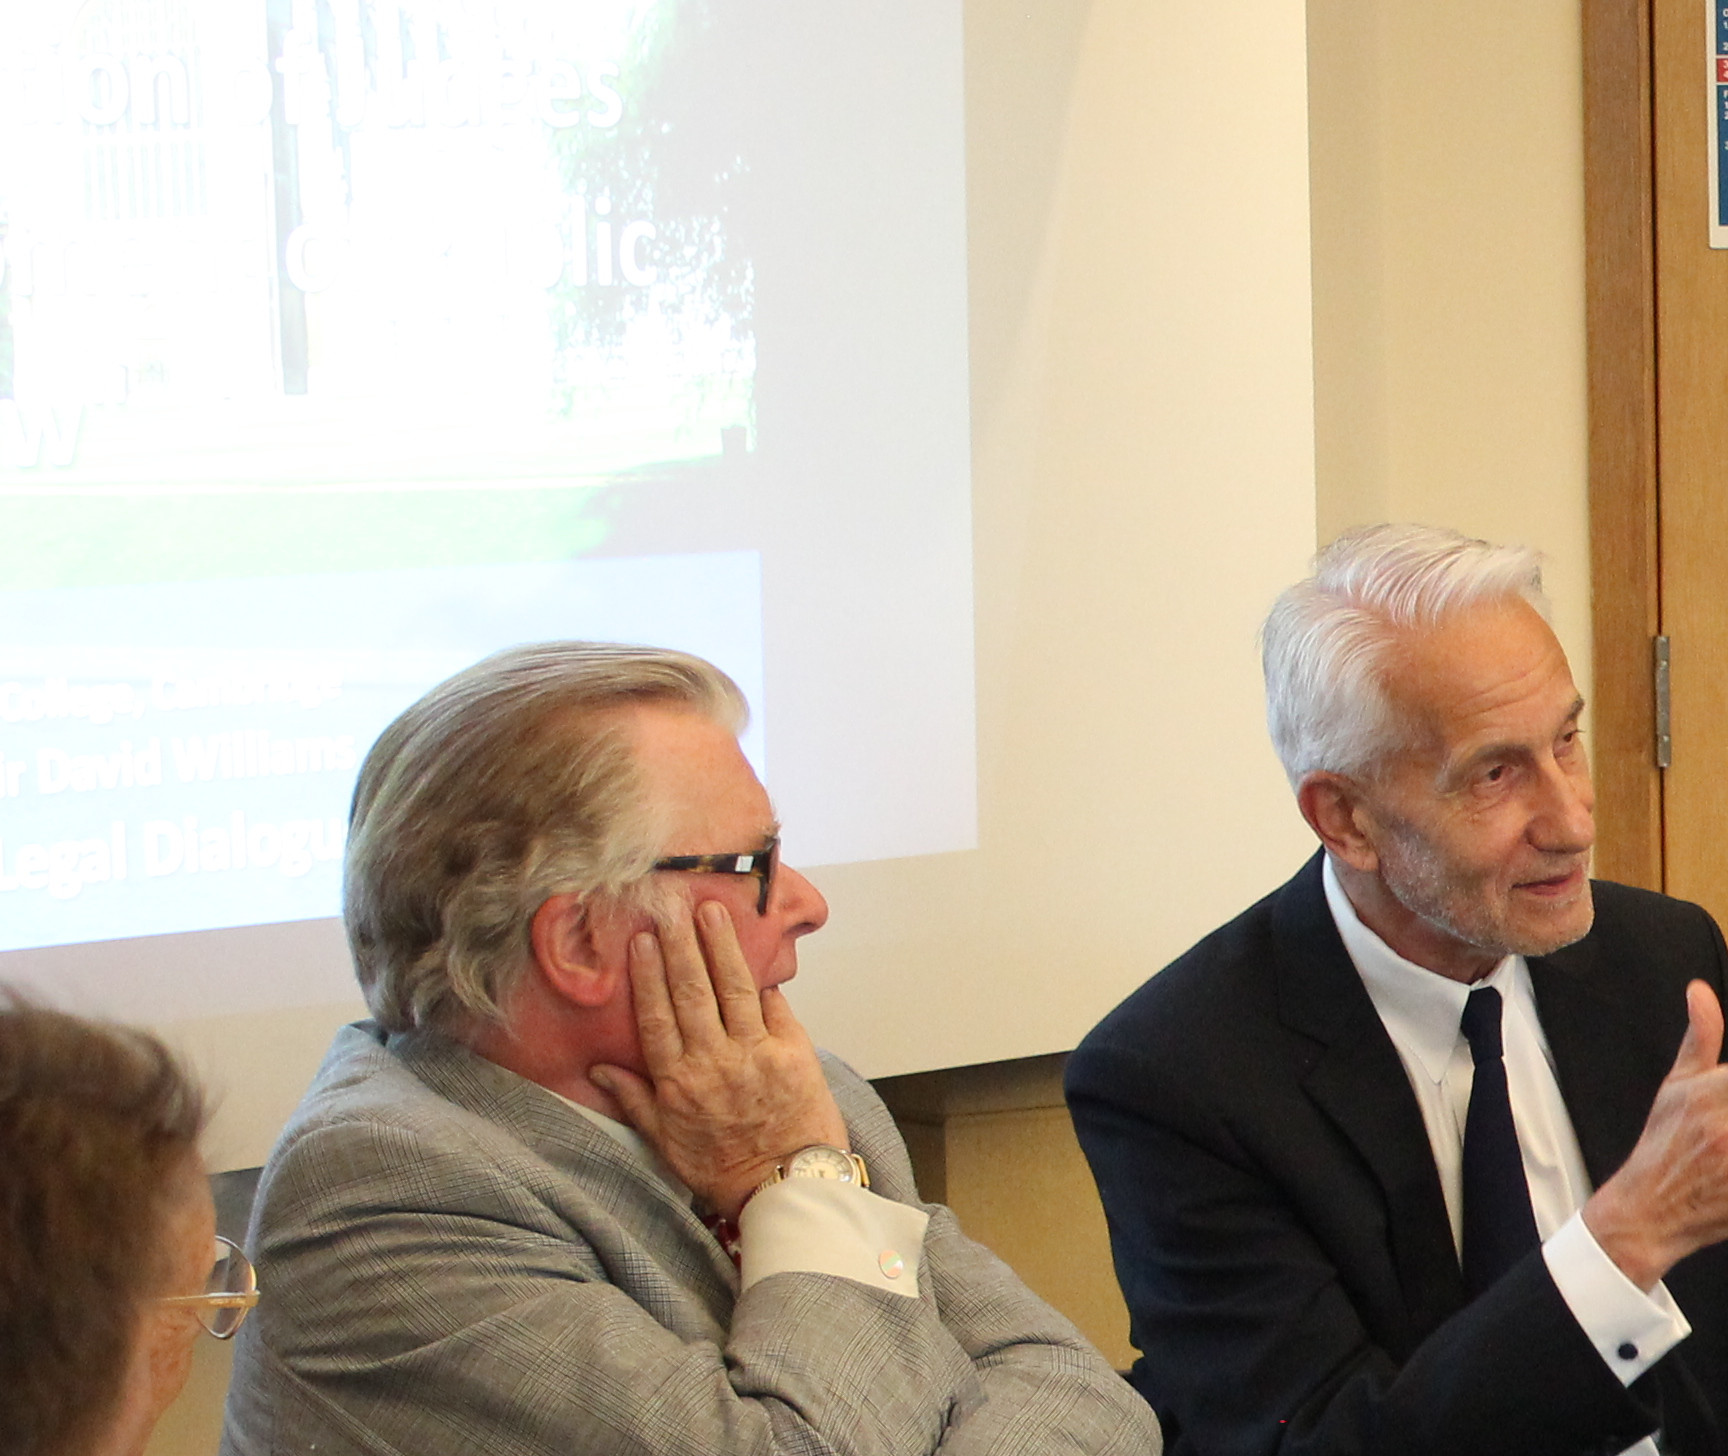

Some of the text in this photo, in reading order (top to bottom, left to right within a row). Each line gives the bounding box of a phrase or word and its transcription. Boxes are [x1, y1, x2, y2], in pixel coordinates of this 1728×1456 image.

[37, 736, 163, 794] David
[171, 728, 358, 783] Williams
[0, 809, 347, 900] Legal Dialogu
